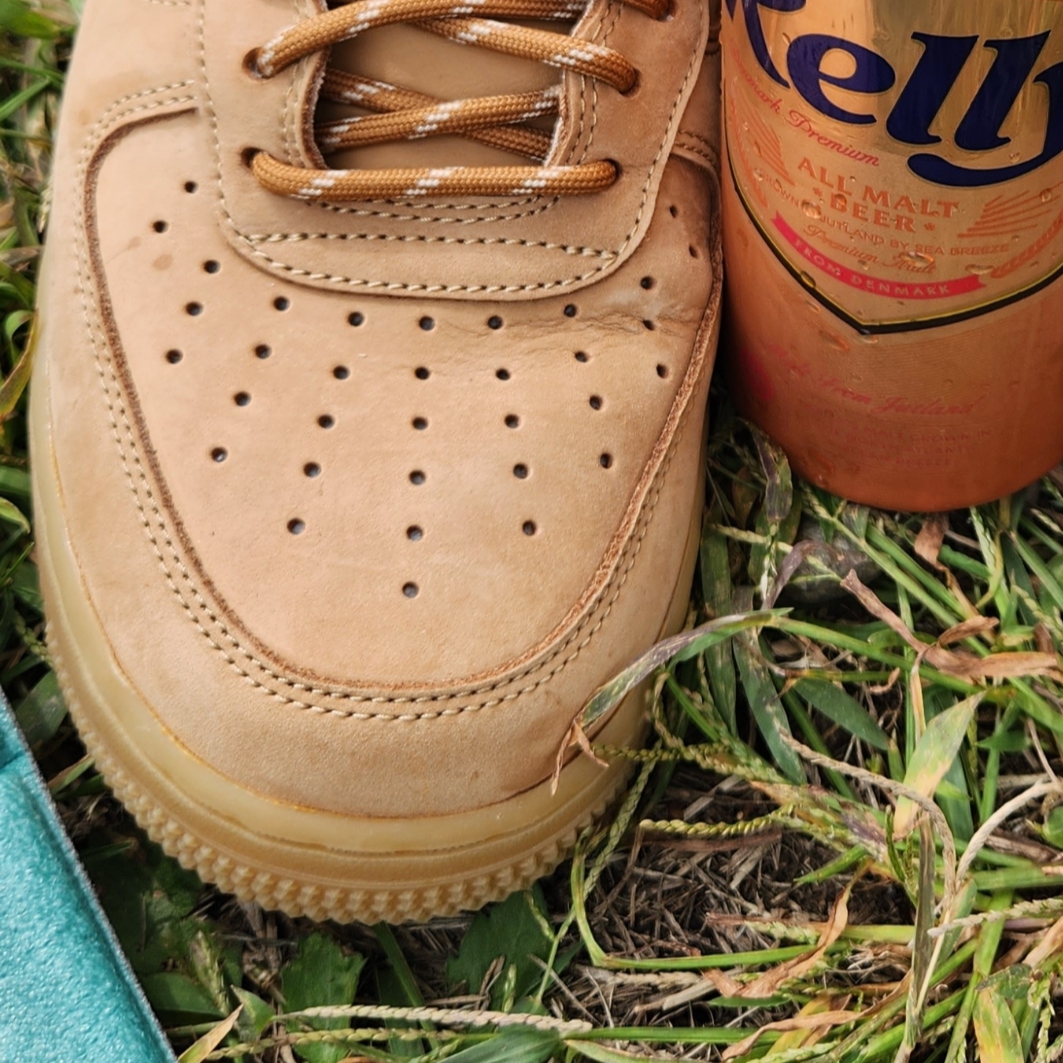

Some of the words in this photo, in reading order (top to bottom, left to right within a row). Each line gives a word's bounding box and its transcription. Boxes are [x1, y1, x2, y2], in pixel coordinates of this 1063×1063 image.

[783, 109, 880, 167] Premium
[798, 157, 852, 196] ALL
[862, 184, 960, 220] MALT
[830, 192, 916, 233] BEER
[795, 239, 844, 276] FROM
[850, 274, 950, 297] DENMARK
[890, 236, 910, 250] BY
[915, 243, 945, 256] SEA
[950, 243, 1010, 256] BREEZE
